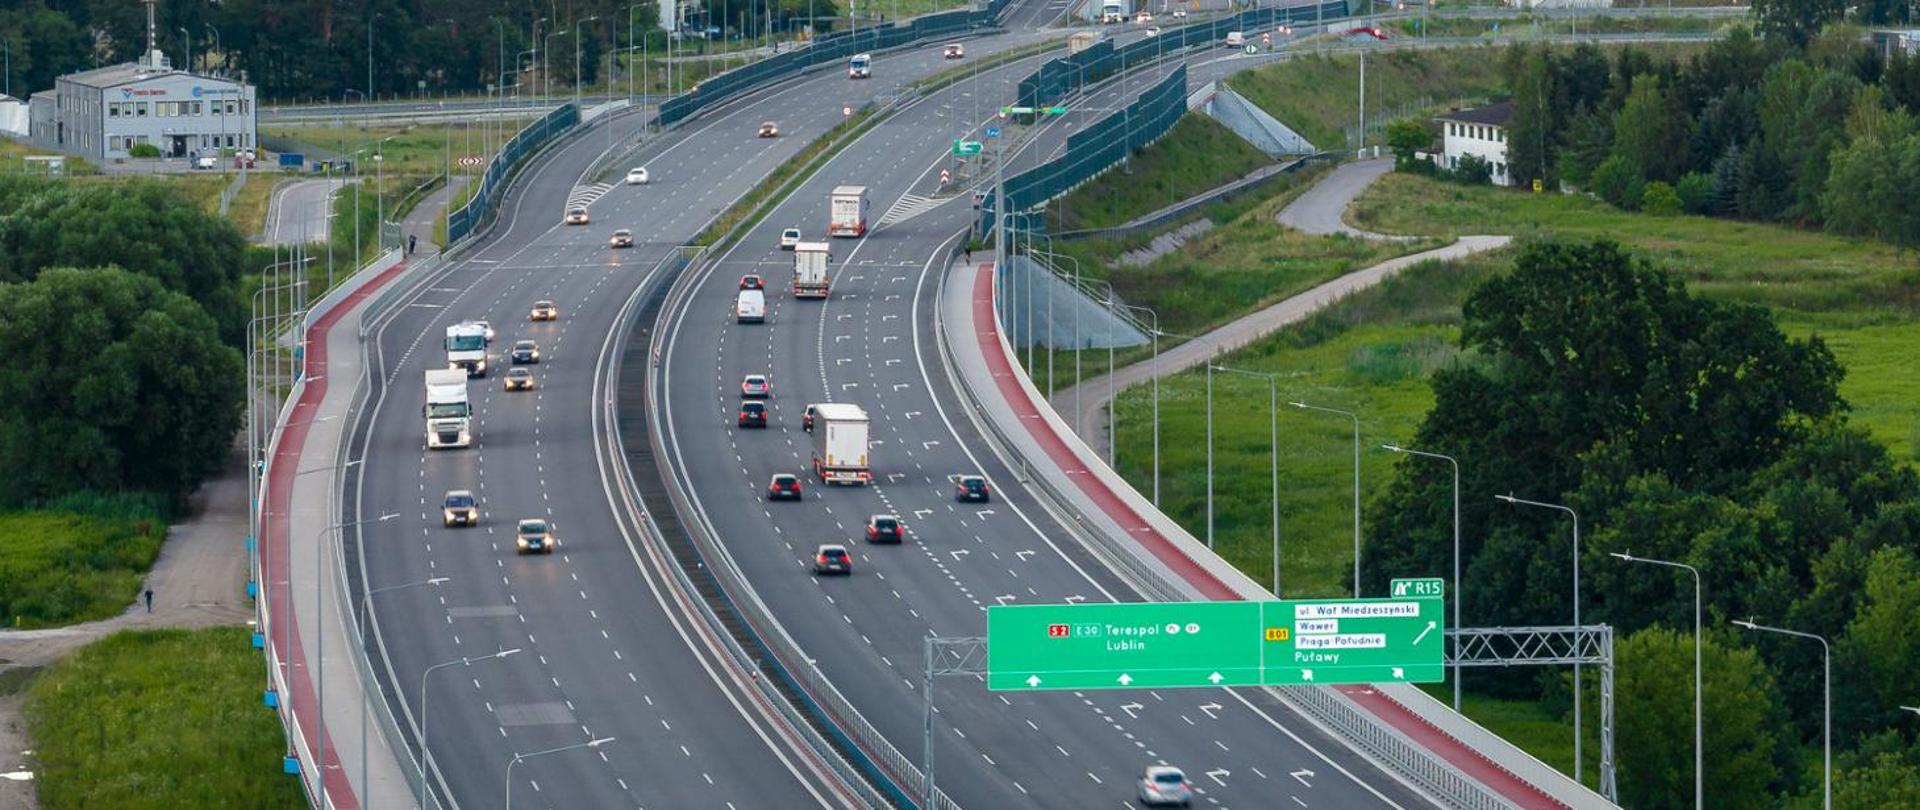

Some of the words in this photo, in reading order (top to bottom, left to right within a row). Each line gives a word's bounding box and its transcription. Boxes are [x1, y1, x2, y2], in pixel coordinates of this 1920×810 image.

[1416, 582, 1440, 594] R15
[1105, 624, 1160, 638] Terespol
[1300, 622, 1334, 630] Wawer
[1269, 629, 1287, 639] 801
[1107, 640, 1145, 650] Lublin
[1295, 651, 1340, 664] Puławy
